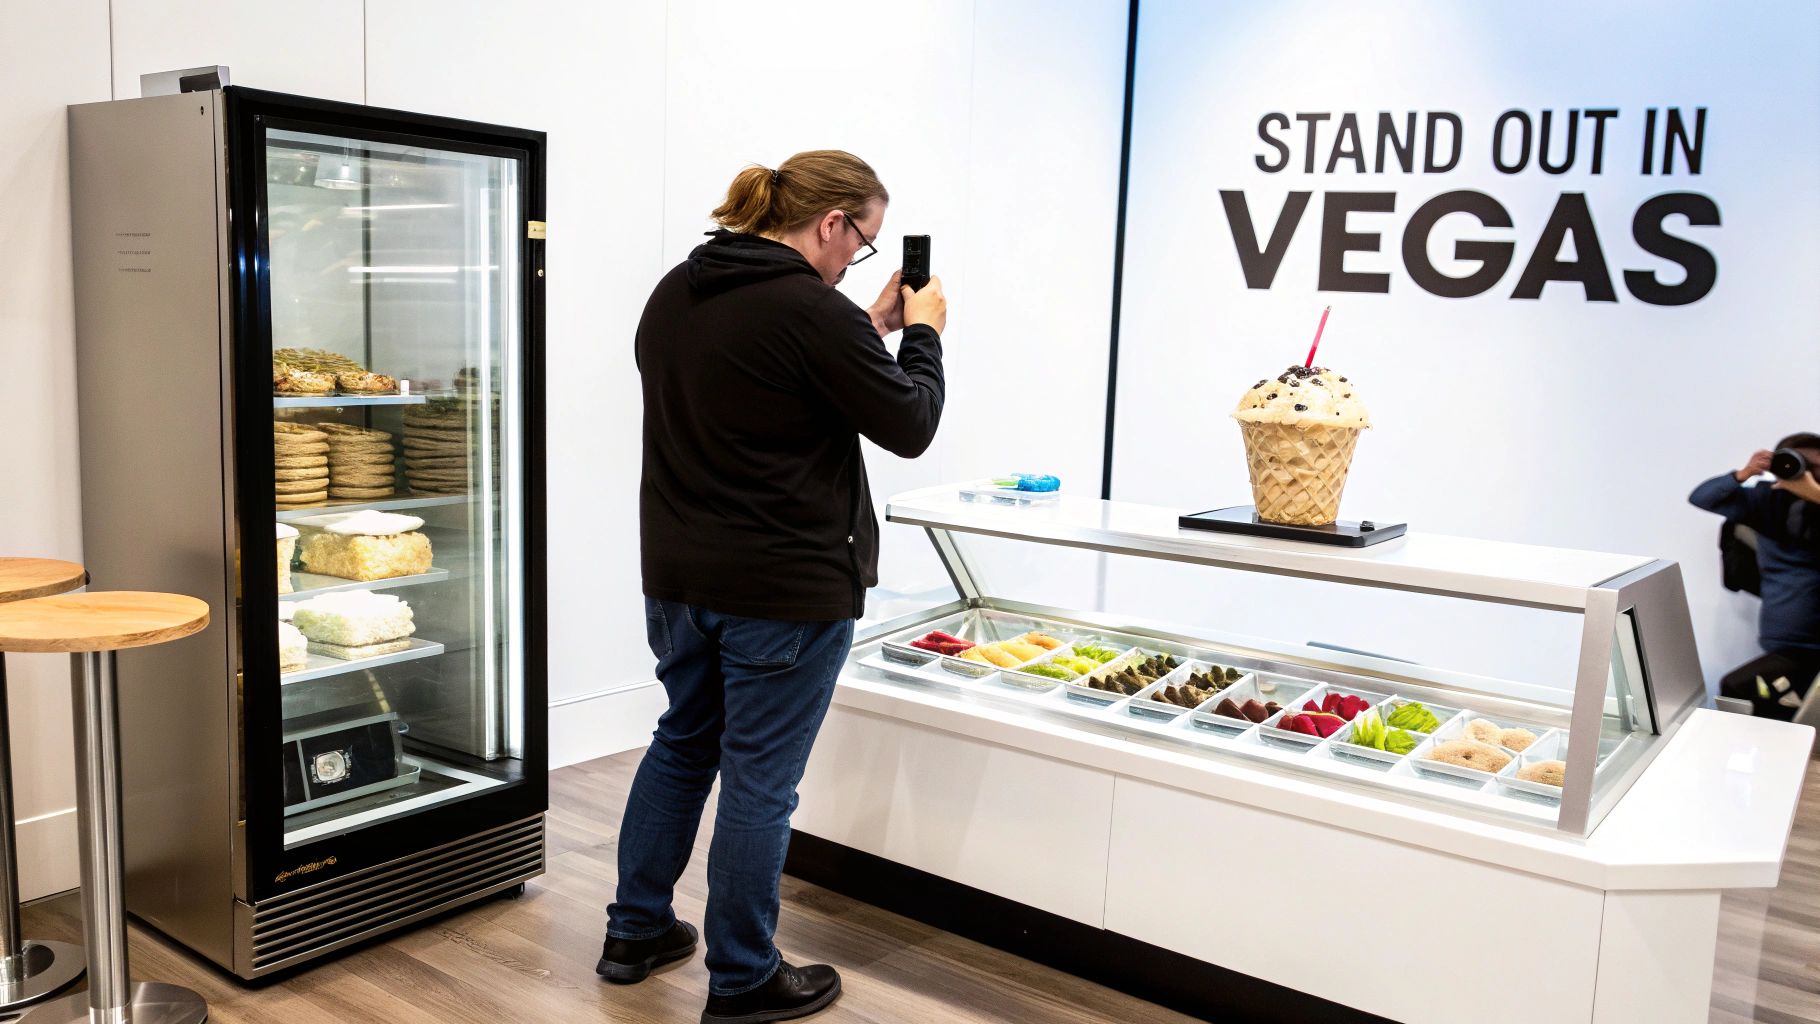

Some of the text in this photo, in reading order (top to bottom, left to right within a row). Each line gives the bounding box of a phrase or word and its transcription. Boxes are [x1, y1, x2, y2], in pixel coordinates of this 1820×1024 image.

[1255, 107, 1708, 176] STAND OUT IN
[1218, 189, 1722, 307] VEGAS
